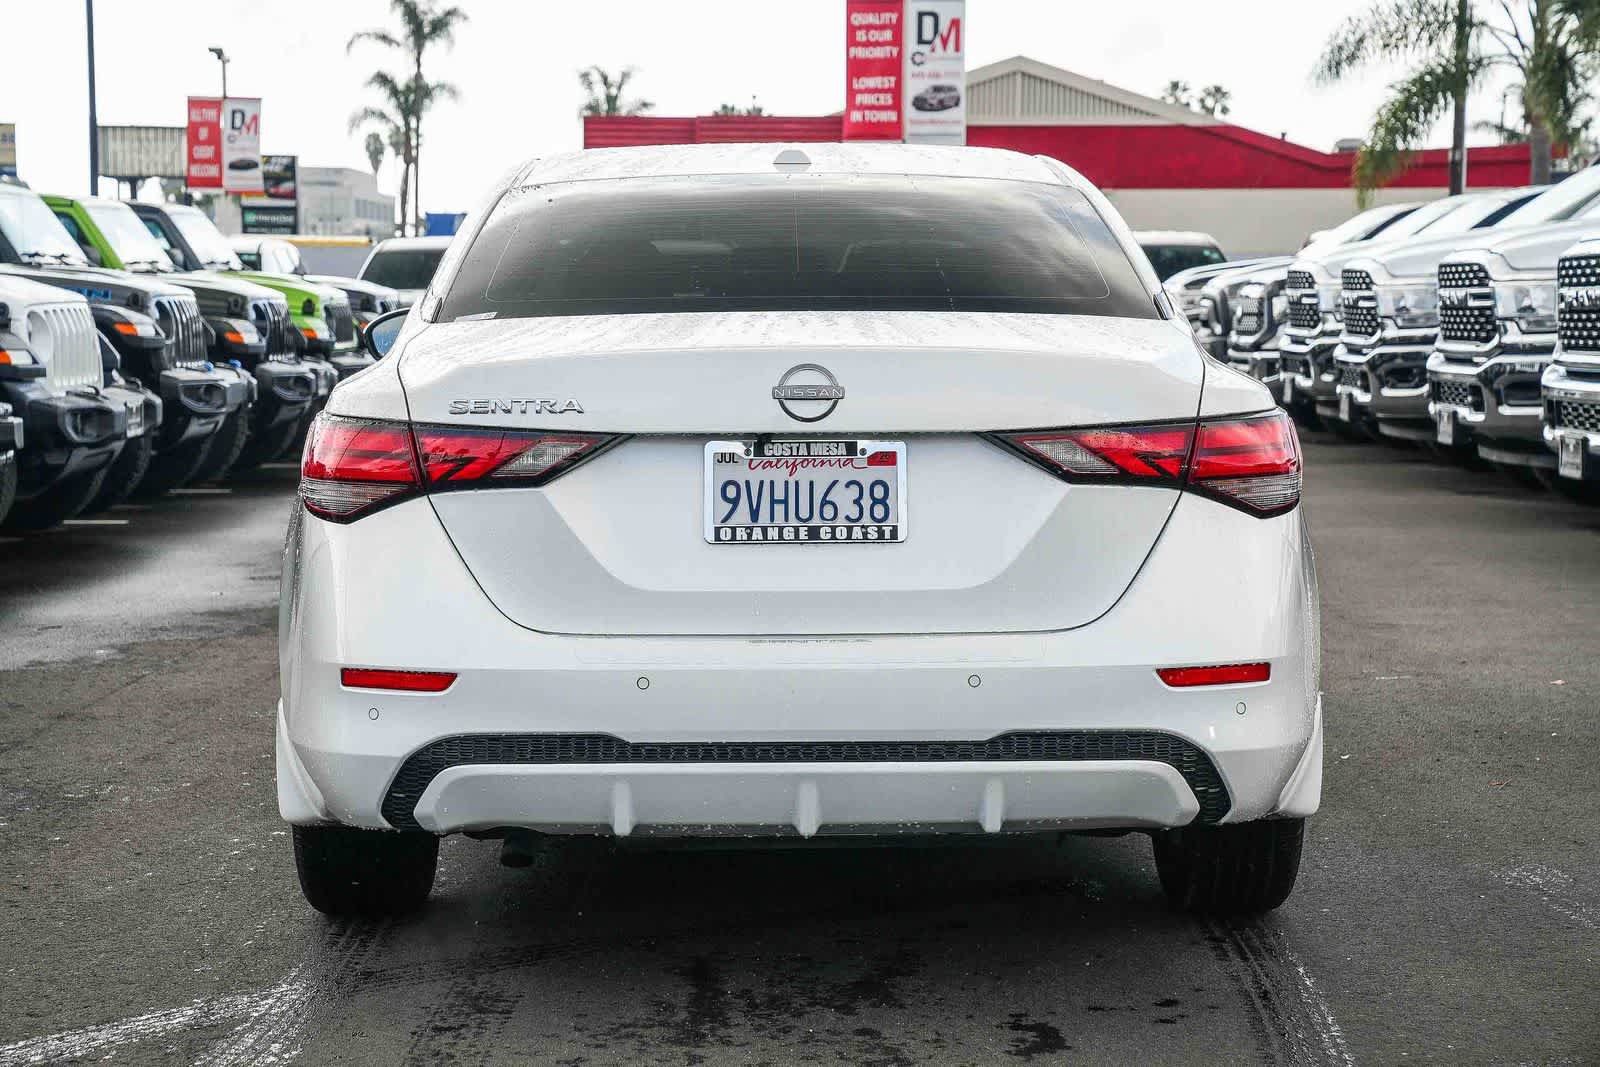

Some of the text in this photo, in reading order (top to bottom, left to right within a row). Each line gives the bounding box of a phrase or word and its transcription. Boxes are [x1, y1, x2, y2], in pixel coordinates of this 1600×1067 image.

[850, 12, 898, 25] QUALITY
[855, 30, 893, 42] IS OUR
[849, 46, 899, 59] PRIORITY
[852, 76, 896, 90] LOWEST
[855, 93, 893, 106] PRICES
[850, 110, 897, 122] IN TOWN
[774, 387, 843, 399] NISSAN
[448, 398, 585, 415] SENTRA
[763, 442, 847, 457] COSTA MESA
[716, 453, 738, 464] JUL
[748, 458, 868, 477] California
[720, 479, 890, 524] 9VHU638
[719, 526, 893, 541] ORANGE COAST
